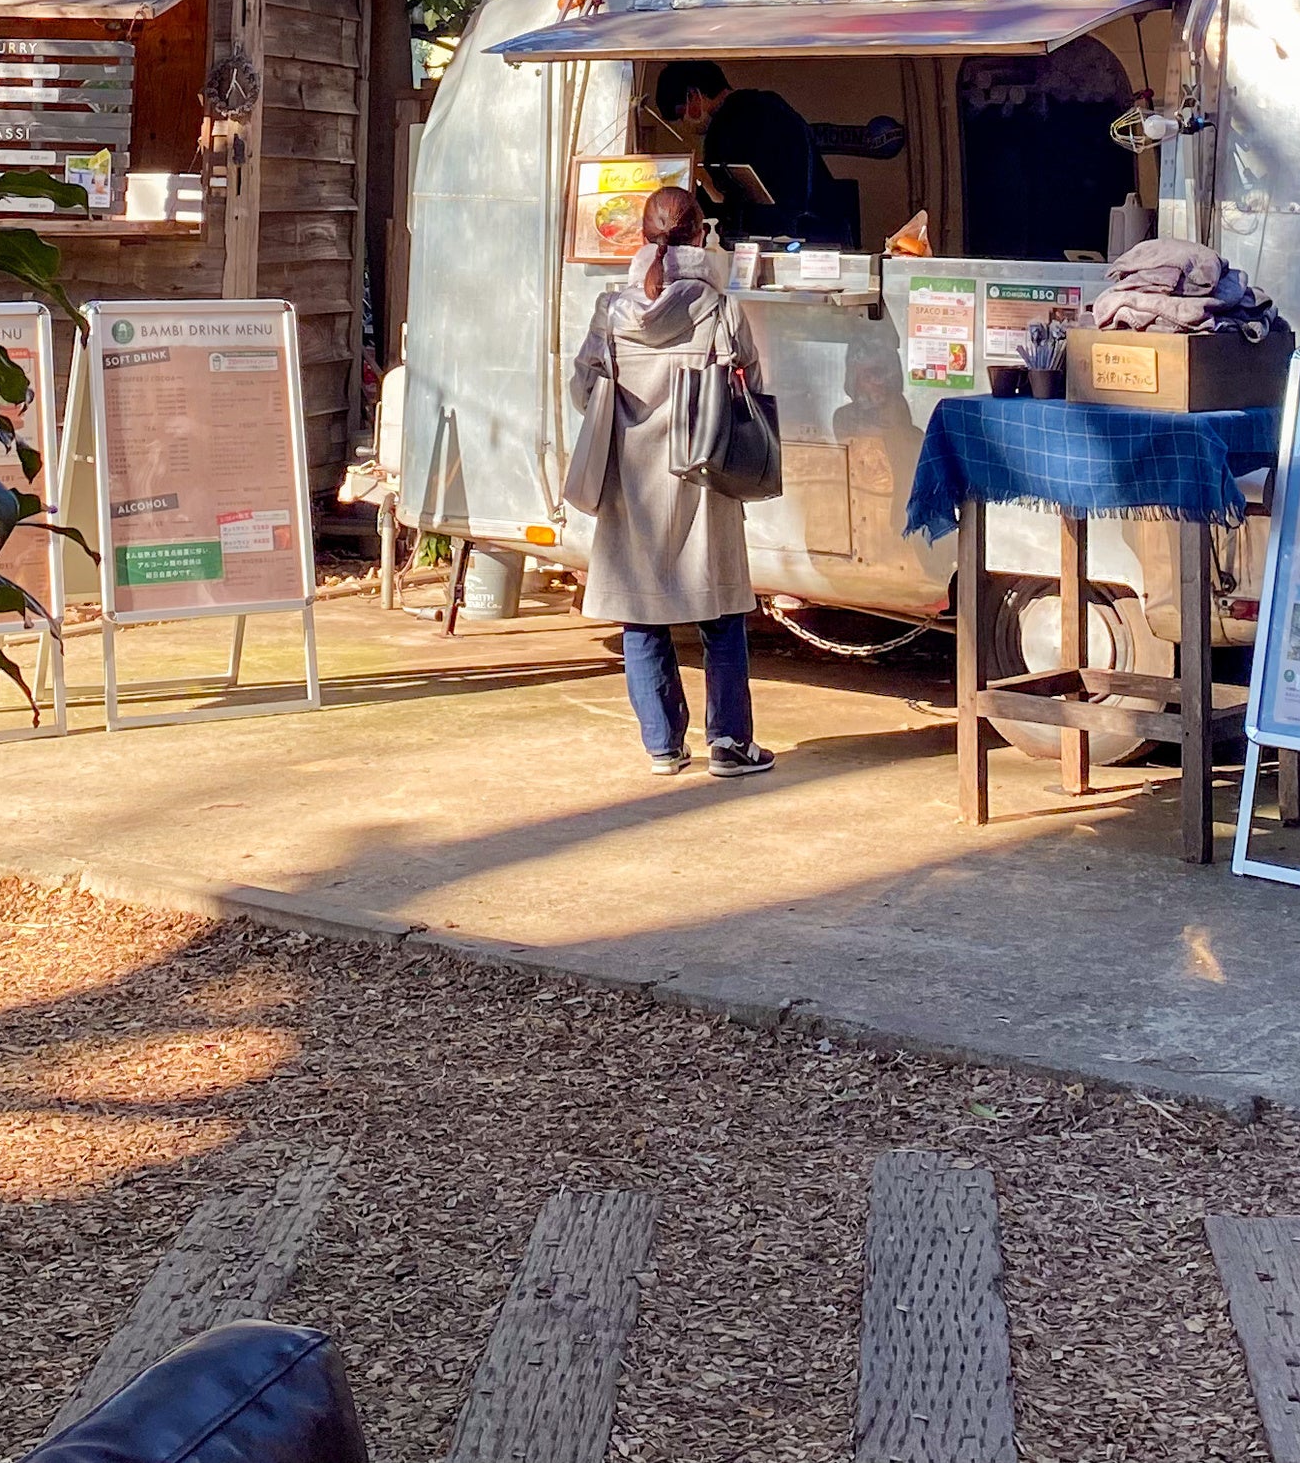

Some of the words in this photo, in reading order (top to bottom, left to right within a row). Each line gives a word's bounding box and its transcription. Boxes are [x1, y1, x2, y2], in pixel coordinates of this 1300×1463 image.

[1032, 289, 1055, 300] BBQ
[140, 325, 183, 337] BAMBI
[189, 324, 231, 336] DRINK
[235, 324, 273, 336] MENU
[104, 354, 131, 367] SOFT
[133, 350, 168, 364] DRINK
[117, 498, 168, 515] ALCOHOL
